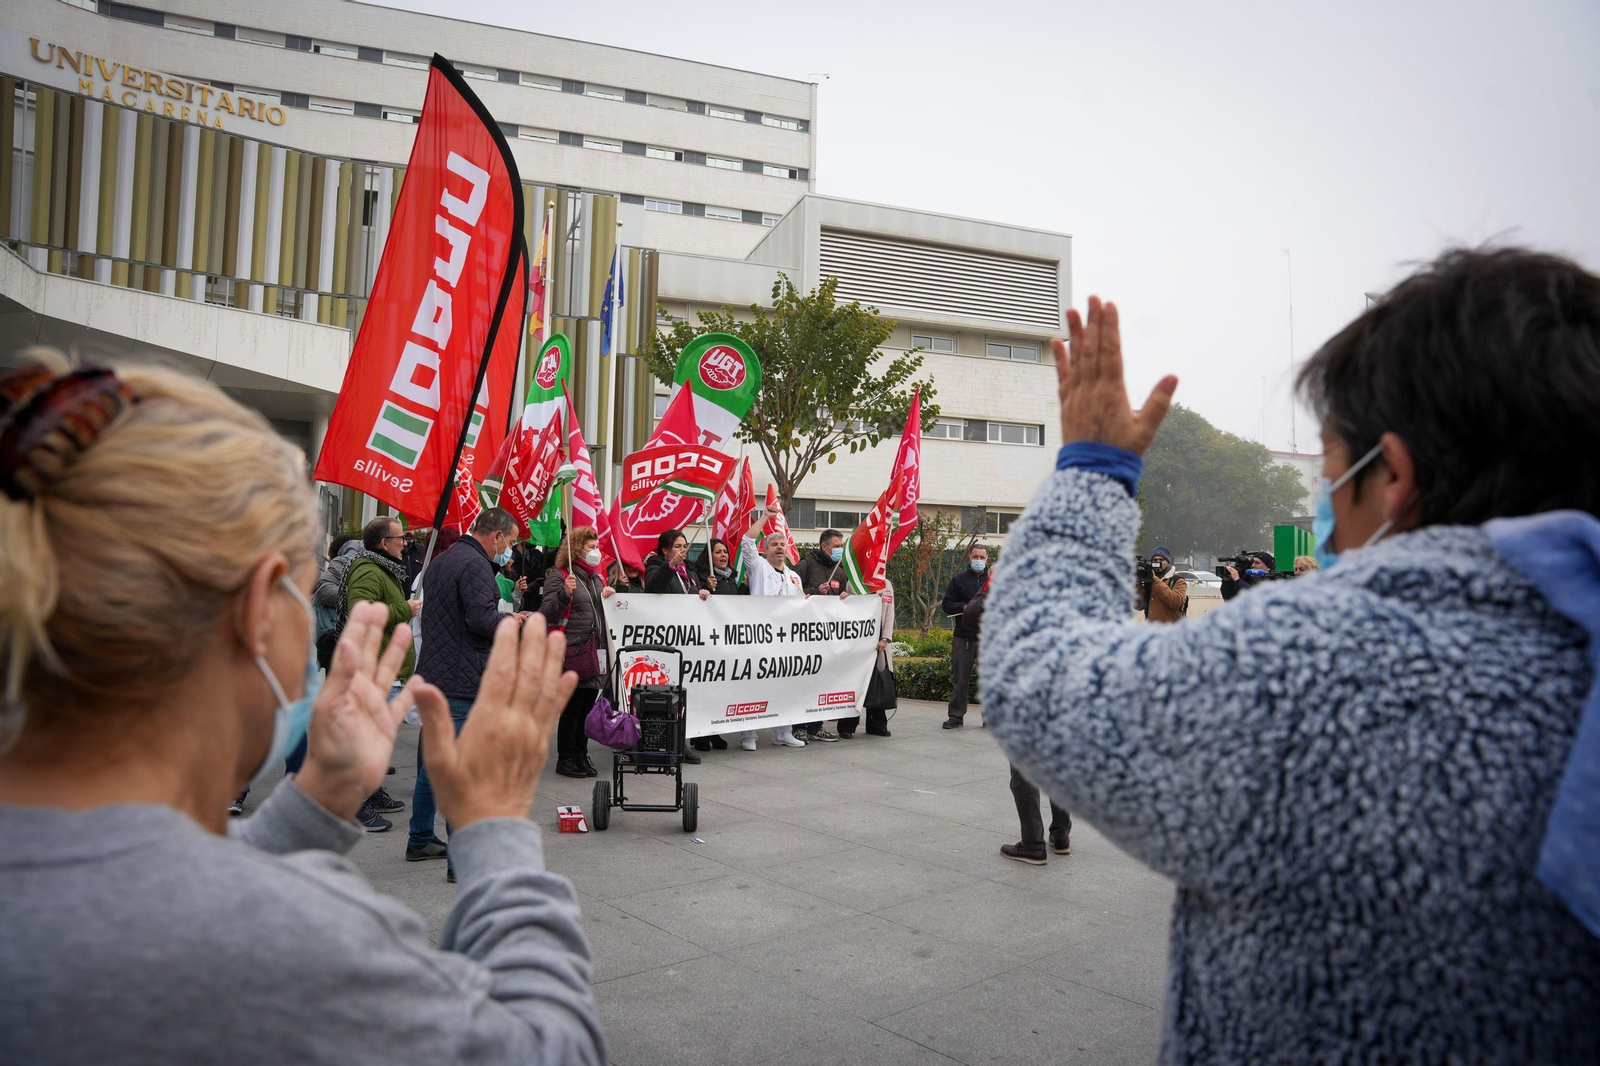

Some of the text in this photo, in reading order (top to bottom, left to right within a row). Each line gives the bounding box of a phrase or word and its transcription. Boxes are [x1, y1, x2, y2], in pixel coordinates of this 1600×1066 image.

[29, 37, 287, 126] UNIVERSITARIO
[78, 78, 225, 130] MACARENA
[705, 348, 744, 379] UGT
[622, 624, 705, 646] PERSONAL
[725, 623, 773, 646] MEDIOS
[791, 619, 876, 642] PRESUPUESTOS
[682, 654, 823, 683] PARA LA SANIDAD
